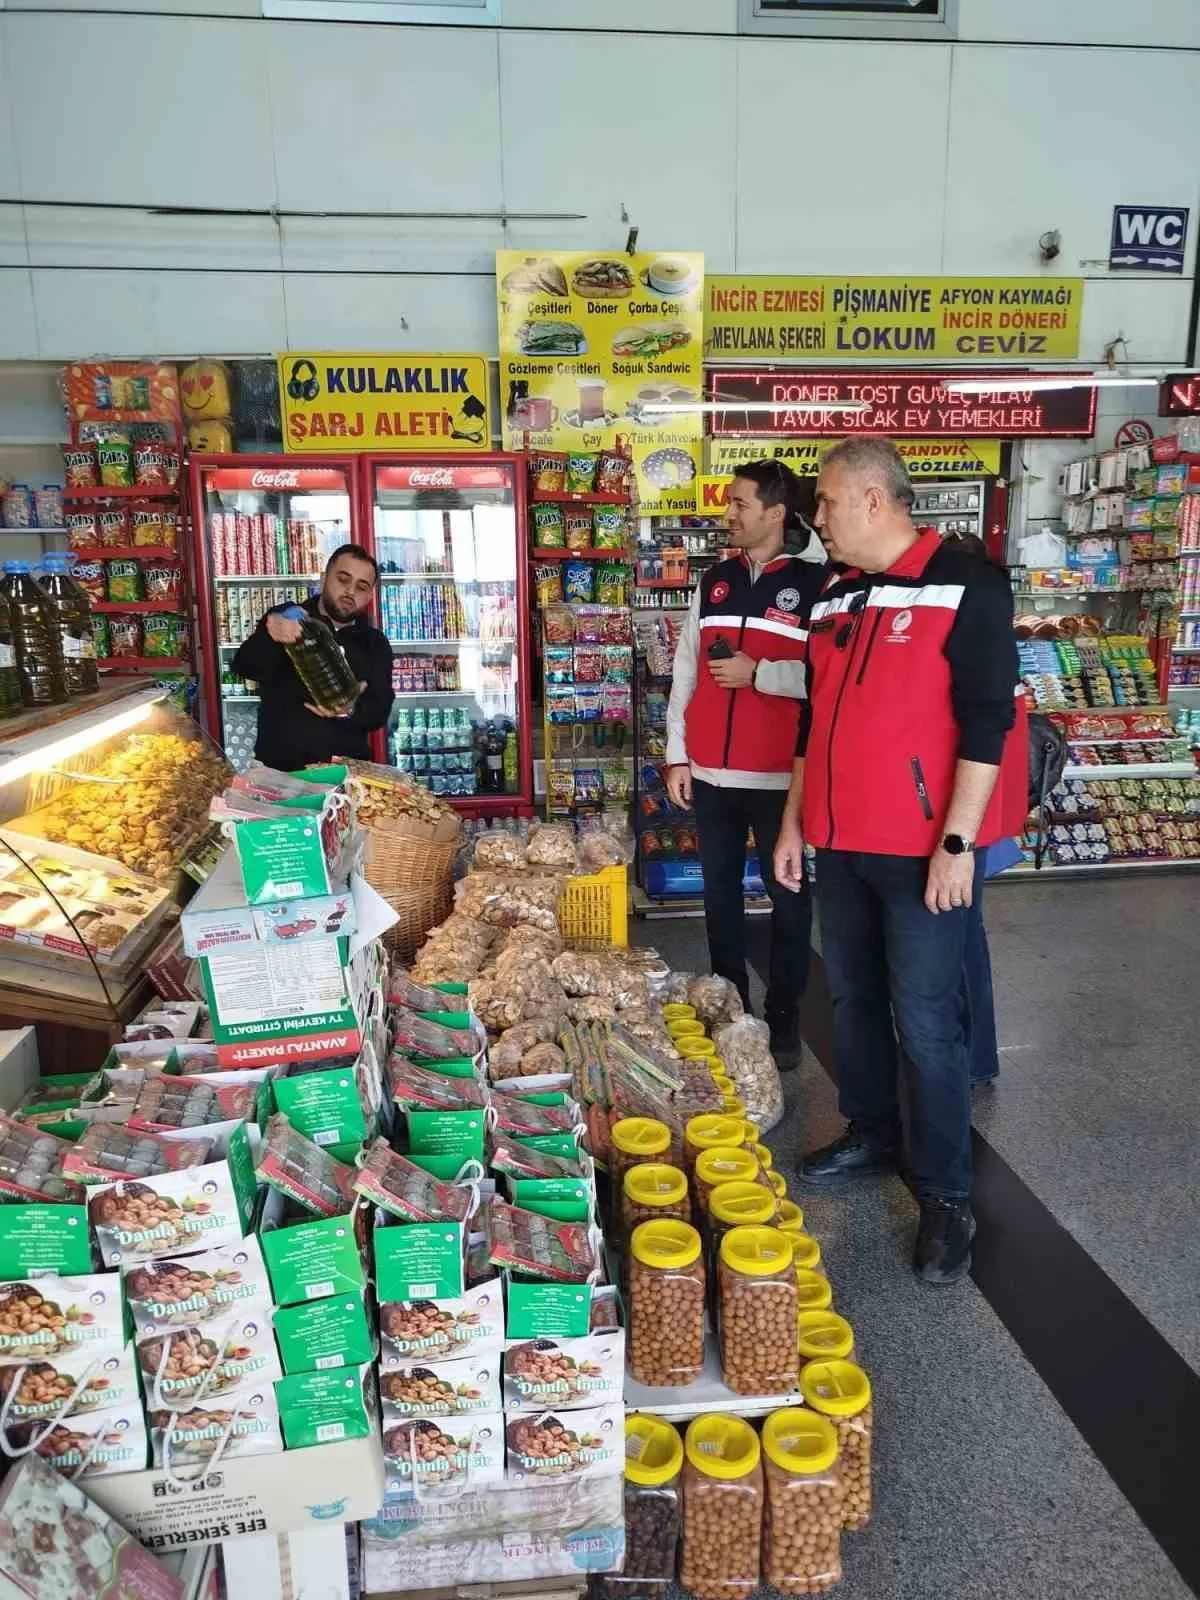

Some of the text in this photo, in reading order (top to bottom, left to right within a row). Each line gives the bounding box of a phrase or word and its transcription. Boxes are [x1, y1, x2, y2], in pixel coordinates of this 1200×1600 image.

[1119, 213, 1182, 246] WC
[711, 284, 825, 313] İNCİR EZMESİ
[832, 282, 932, 319] PİŞMANİYE
[940, 286, 1072, 305] AFYON KAYMAĞI
[587, 301, 619, 314] Döner
[628, 301, 658, 316] Çorba
[943, 308, 1068, 329] İNCİR DÖNERİ
[712, 321, 826, 355] MEVLANA ŞEKERİ
[836, 326, 936, 350] LOKUM
[956, 331, 1048, 353] CEVİZ
[508, 362, 554, 375] Gözleme
[612, 362, 644, 376] Soğuk
[326, 367, 470, 393] KULAKLIK
[847, 385, 901, 404] TOST
[289, 406, 450, 443] ŞARJ ALETİ
[774, 405, 1042, 428] TAVUK SICAK EV YEMEKLERİ
[582, 433, 602, 448] Çay
[632, 432, 654, 444] Türk
[720, 447, 768, 459] TEKEL
[908, 458, 985, 473] GÖZLEME
[251, 470, 299, 488] Coca-Cola
[408, 470, 454, 487] Coca-Cola
[641, 499, 663, 511] ahat
[329, 1013, 344, 1023] TV
[286, 1036, 348, 1054] AVANTAJ
[117, 1222, 178, 1245] Damla
[150, 1296, 209, 1318] Damla
[234, 1518, 267, 1534] EFE
